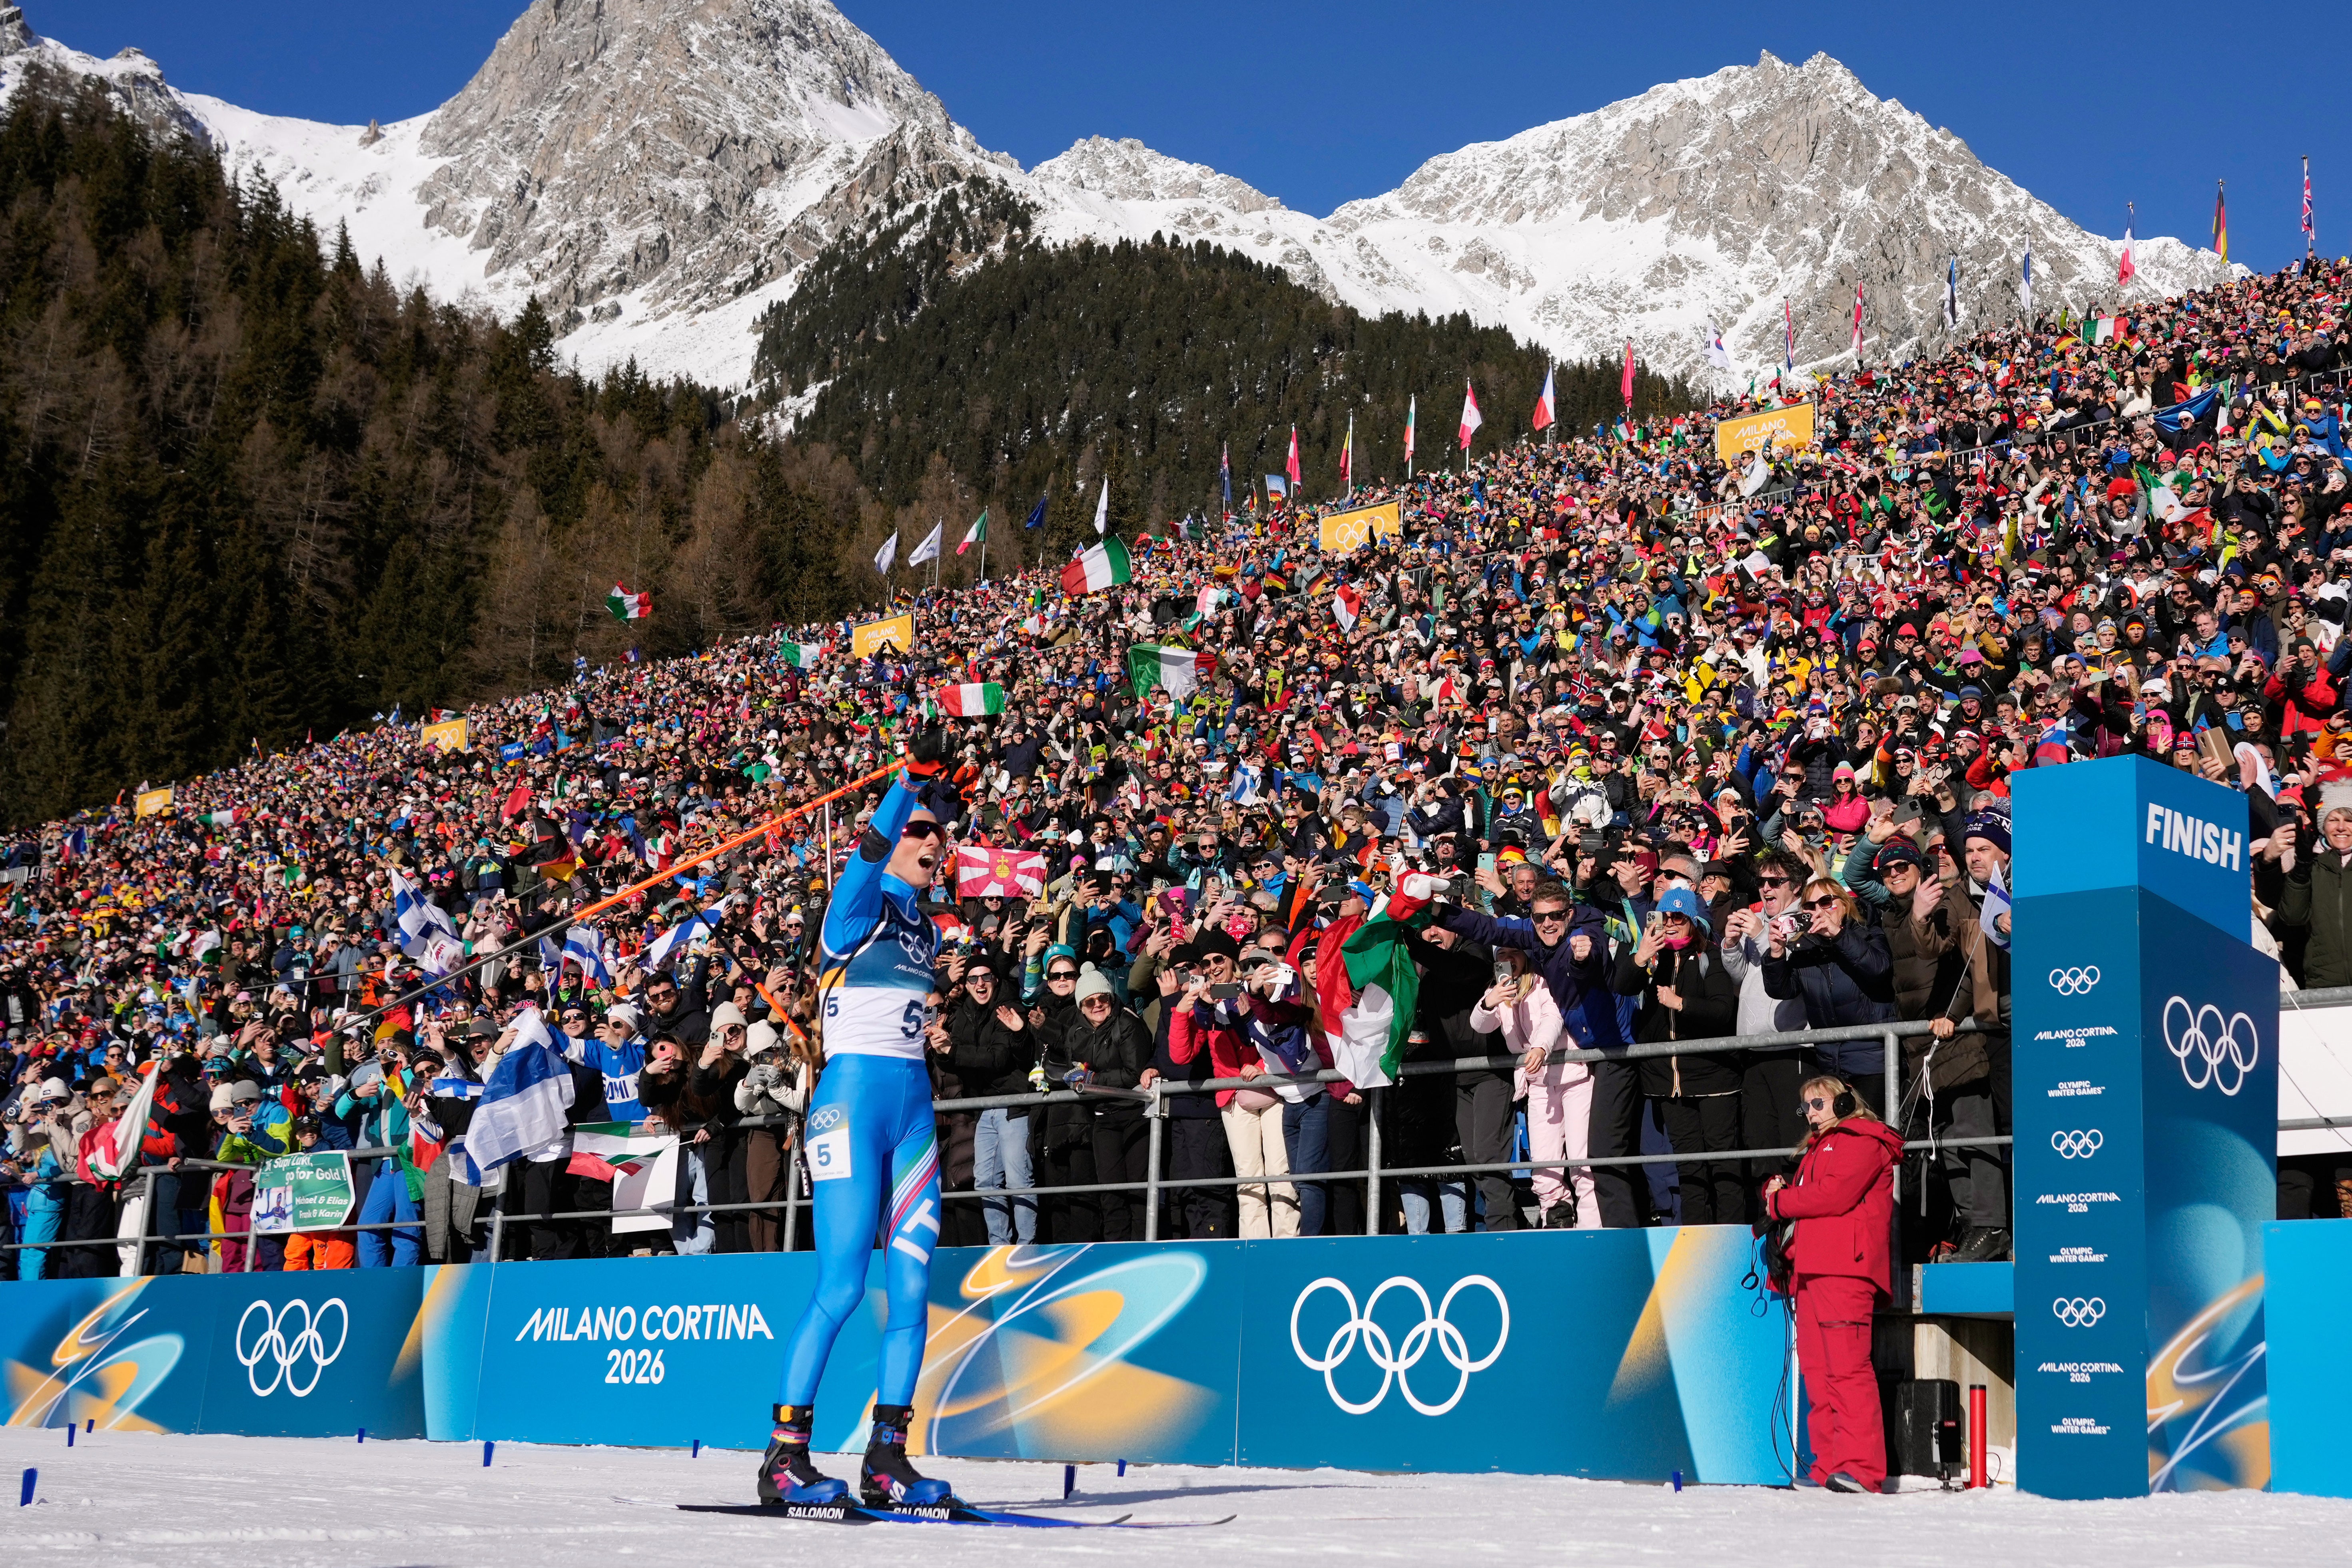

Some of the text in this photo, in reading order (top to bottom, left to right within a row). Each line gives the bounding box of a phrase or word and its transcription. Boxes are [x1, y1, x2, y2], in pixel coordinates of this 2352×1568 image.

[1734, 419, 1786, 439] MILANO
[864, 626, 896, 640] MILANO
[2146, 802, 2241, 872] FINISH
[894, 964, 918, 975] MILANO
[827, 997, 839, 1017] 5
[901, 999, 923, 1039] 5
[2034, 1026, 2118, 1040] MILANO CORTINA
[2066, 1038, 2086, 1047] 2026
[2058, 1081, 2091, 1089] OLYMPIC
[2048, 1089, 2075, 1097] WINTER
[818, 1143, 831, 1166] 5
[273, 1156, 290, 1171] Supi
[285, 1171, 294, 1185] go
[296, 1167, 313, 1179] for
[316, 1168, 341, 1181] Gold
[295, 1196, 316, 1205] Michael
[2036, 1192, 2121, 1204] MILANO CORTINA
[299, 1210, 312, 1219] Frank
[318, 1209, 343, 1217] Karin
[2068, 1203, 2088, 1213] 2026
[2049, 1255, 2077, 1263] WINTER
[515, 1304, 774, 1341] MILANO CORTINA
[605, 1349, 664, 1384] 2026
[2037, 1363, 2124, 1373] MILANO CORTINA
[2070, 1372, 2091, 1382] 2026
[2062, 1418, 2095, 1426] OLYMPIC
[2051, 1425, 2080, 1434] WINTER
[784, 1469, 806, 1486] SALOMON
[787, 1507, 844, 1519] SALOMON
[893, 1508, 950, 1520] SALOMON
